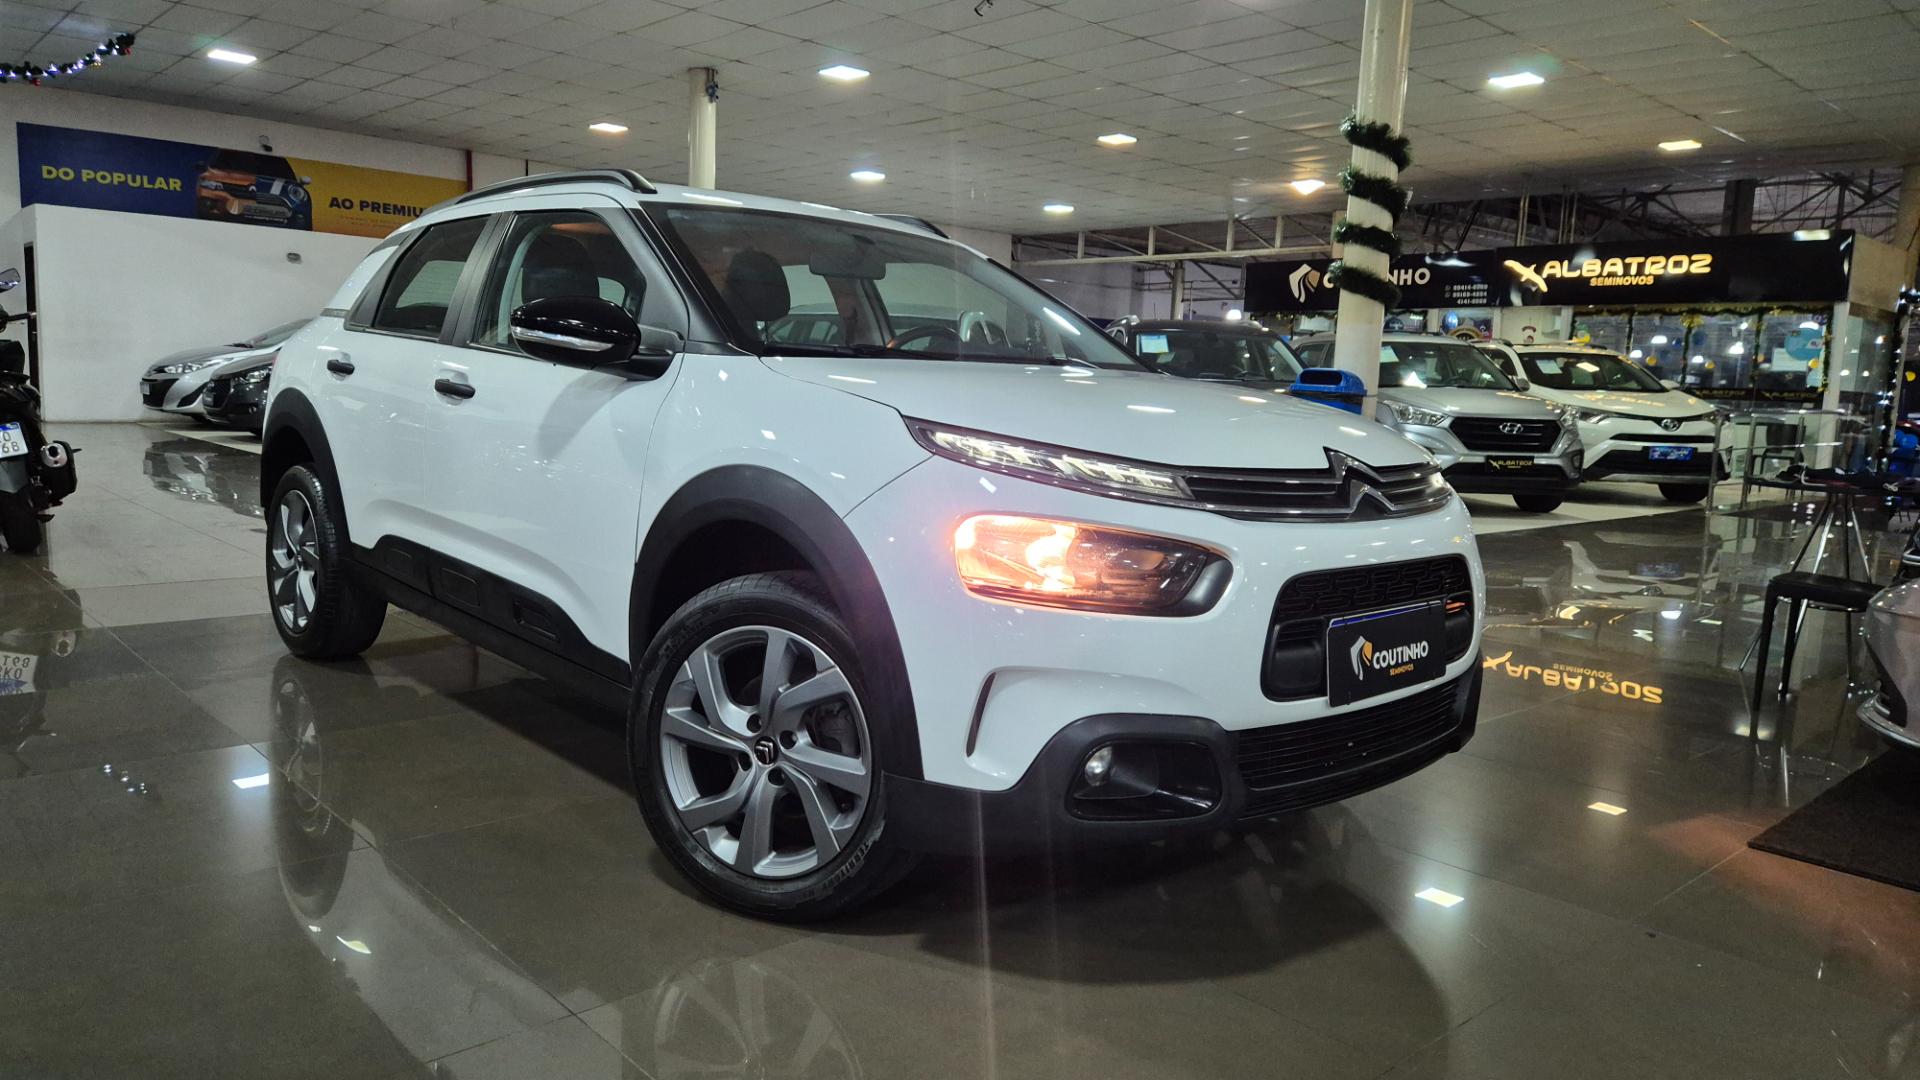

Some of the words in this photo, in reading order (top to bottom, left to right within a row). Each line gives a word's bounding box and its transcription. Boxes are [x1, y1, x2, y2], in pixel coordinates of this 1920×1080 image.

[41, 165, 75, 181] DO
[81, 169, 182, 191] POPULAR
[329, 197, 353, 210] AO
[359, 200, 424, 218] PREMIU
[1590, 275, 1654, 287] SEMINOVOS
[1373, 640, 1429, 669] COUTINHO
